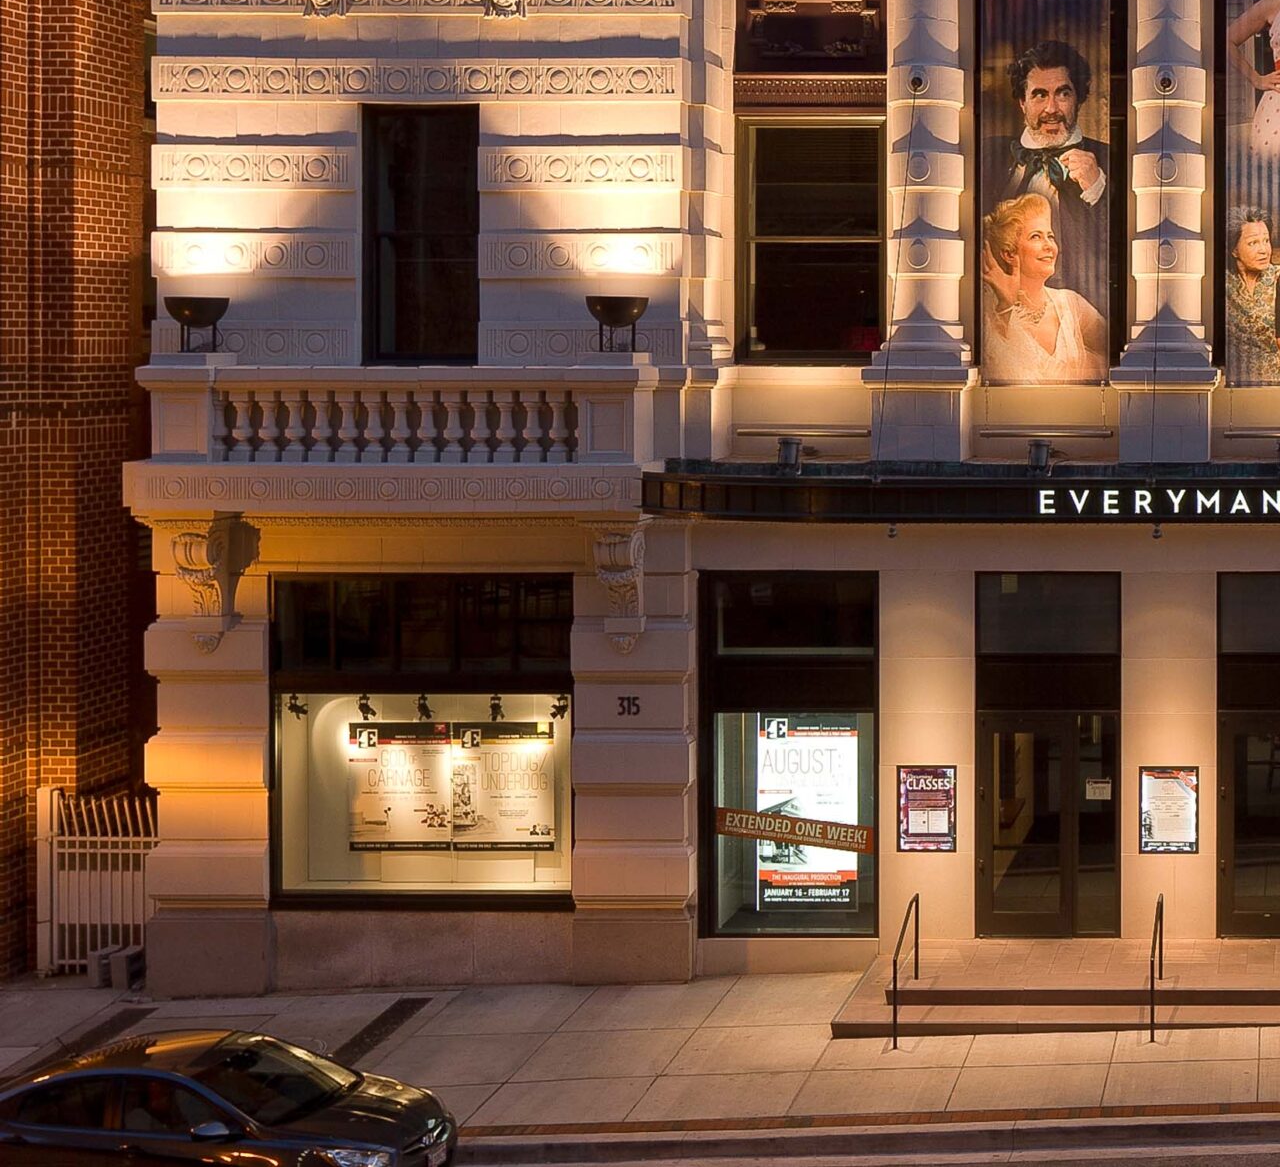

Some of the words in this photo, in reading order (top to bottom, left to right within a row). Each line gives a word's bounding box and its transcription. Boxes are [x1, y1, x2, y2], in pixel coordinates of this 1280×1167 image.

[617, 696, 640, 716] 315
[381, 749, 407, 768] GOD
[480, 752, 548, 772] TOPDOG/
[368, 769, 431, 787] CARNAGE
[481, 773, 548, 791] UNDERDOG
[906, 778, 951, 790] CLASSES
[725, 812, 791, 833] EXTENDED
[795, 821, 823, 838] ONE
[827, 826, 868, 844] WEEK!
[764, 888, 793, 897] JANUARY
[794, 888, 803, 896] 16
[808, 888, 840, 896] FEBRUARY
[842, 888, 850, 896] 17
